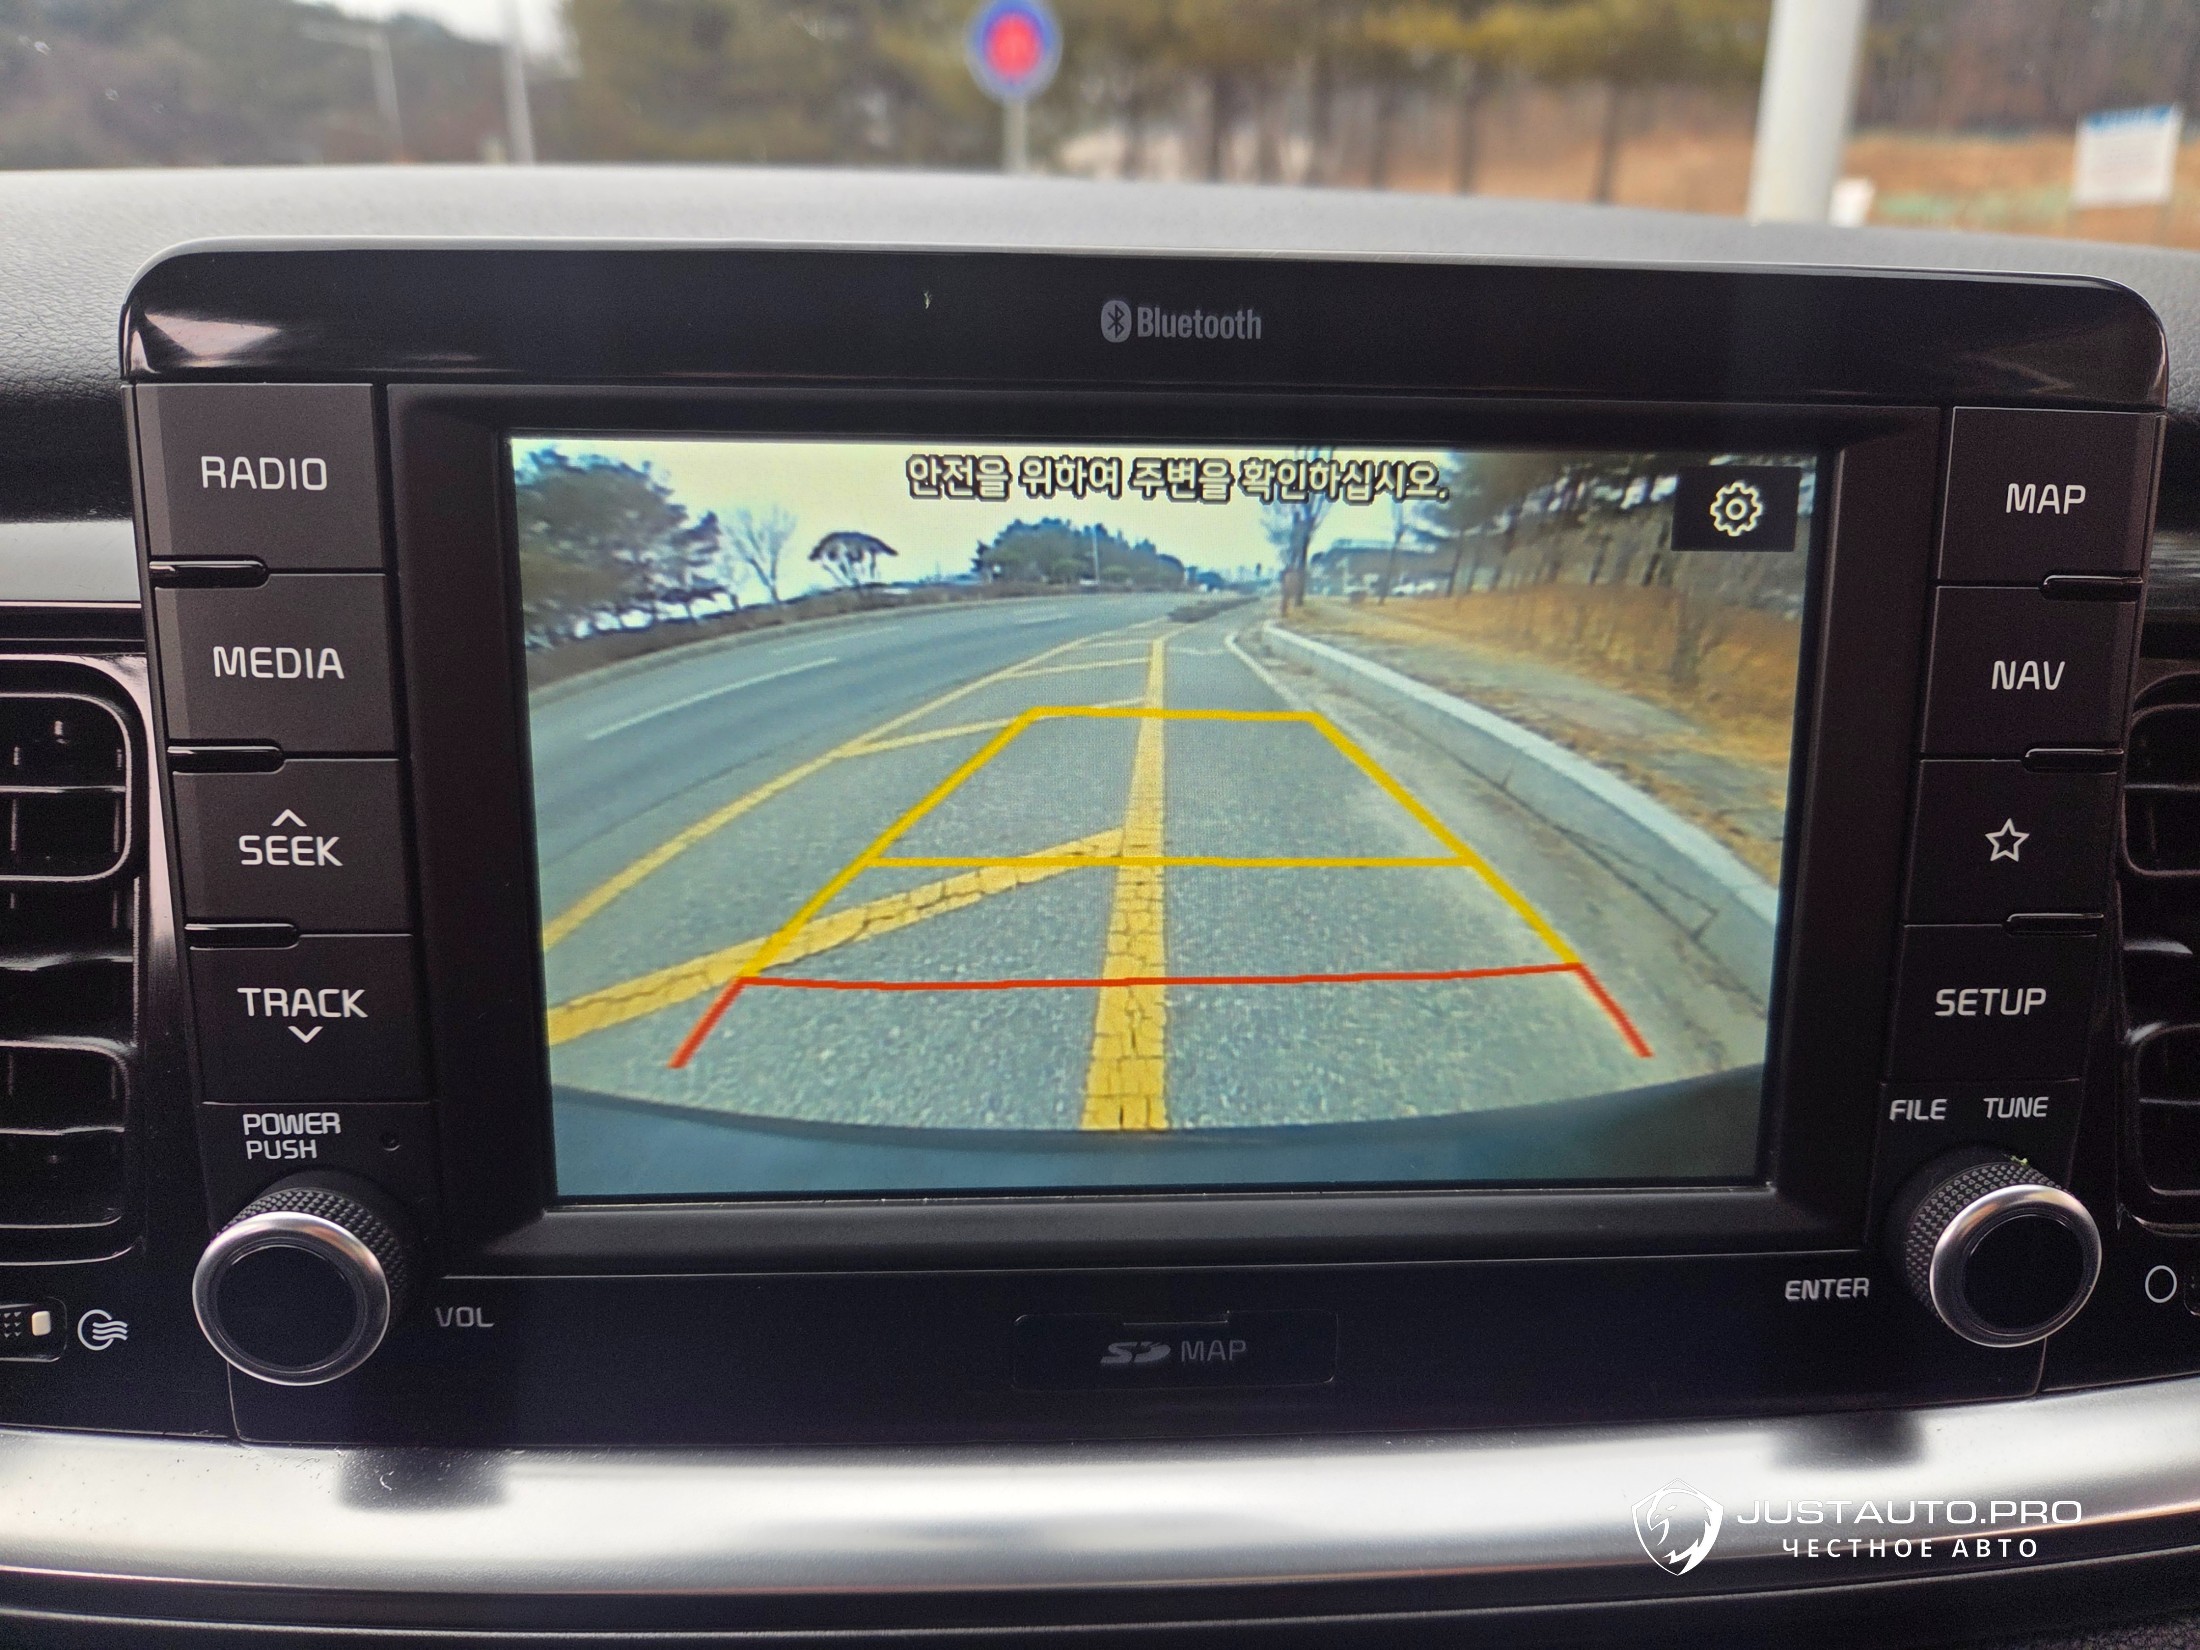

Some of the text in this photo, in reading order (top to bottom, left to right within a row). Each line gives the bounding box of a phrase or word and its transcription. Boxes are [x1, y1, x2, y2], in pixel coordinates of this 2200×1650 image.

[1136, 306, 1263, 341] Bluetooth
[200, 455, 328, 491] RADIO
[906, 455, 1450, 504] 안전을 위하여 주변을 확인하십시오.
[2005, 483, 2087, 515] MAP
[212, 646, 345, 680] MEDIA
[1990, 660, 2066, 691] NAV
[239, 835, 343, 867] SEEK
[237, 987, 368, 1019] TRACK
[1935, 988, 2048, 1017] SETUP
[1889, 1097, 1948, 1121] FILE
[1983, 1096, 2049, 1119] TUNE
[242, 1112, 342, 1137] POWER
[245, 1139, 318, 1160] PUSH
[1784, 1277, 1870, 1301] ENTER
[434, 1306, 495, 1329] VOL
[1180, 1339, 1248, 1363] MAP
